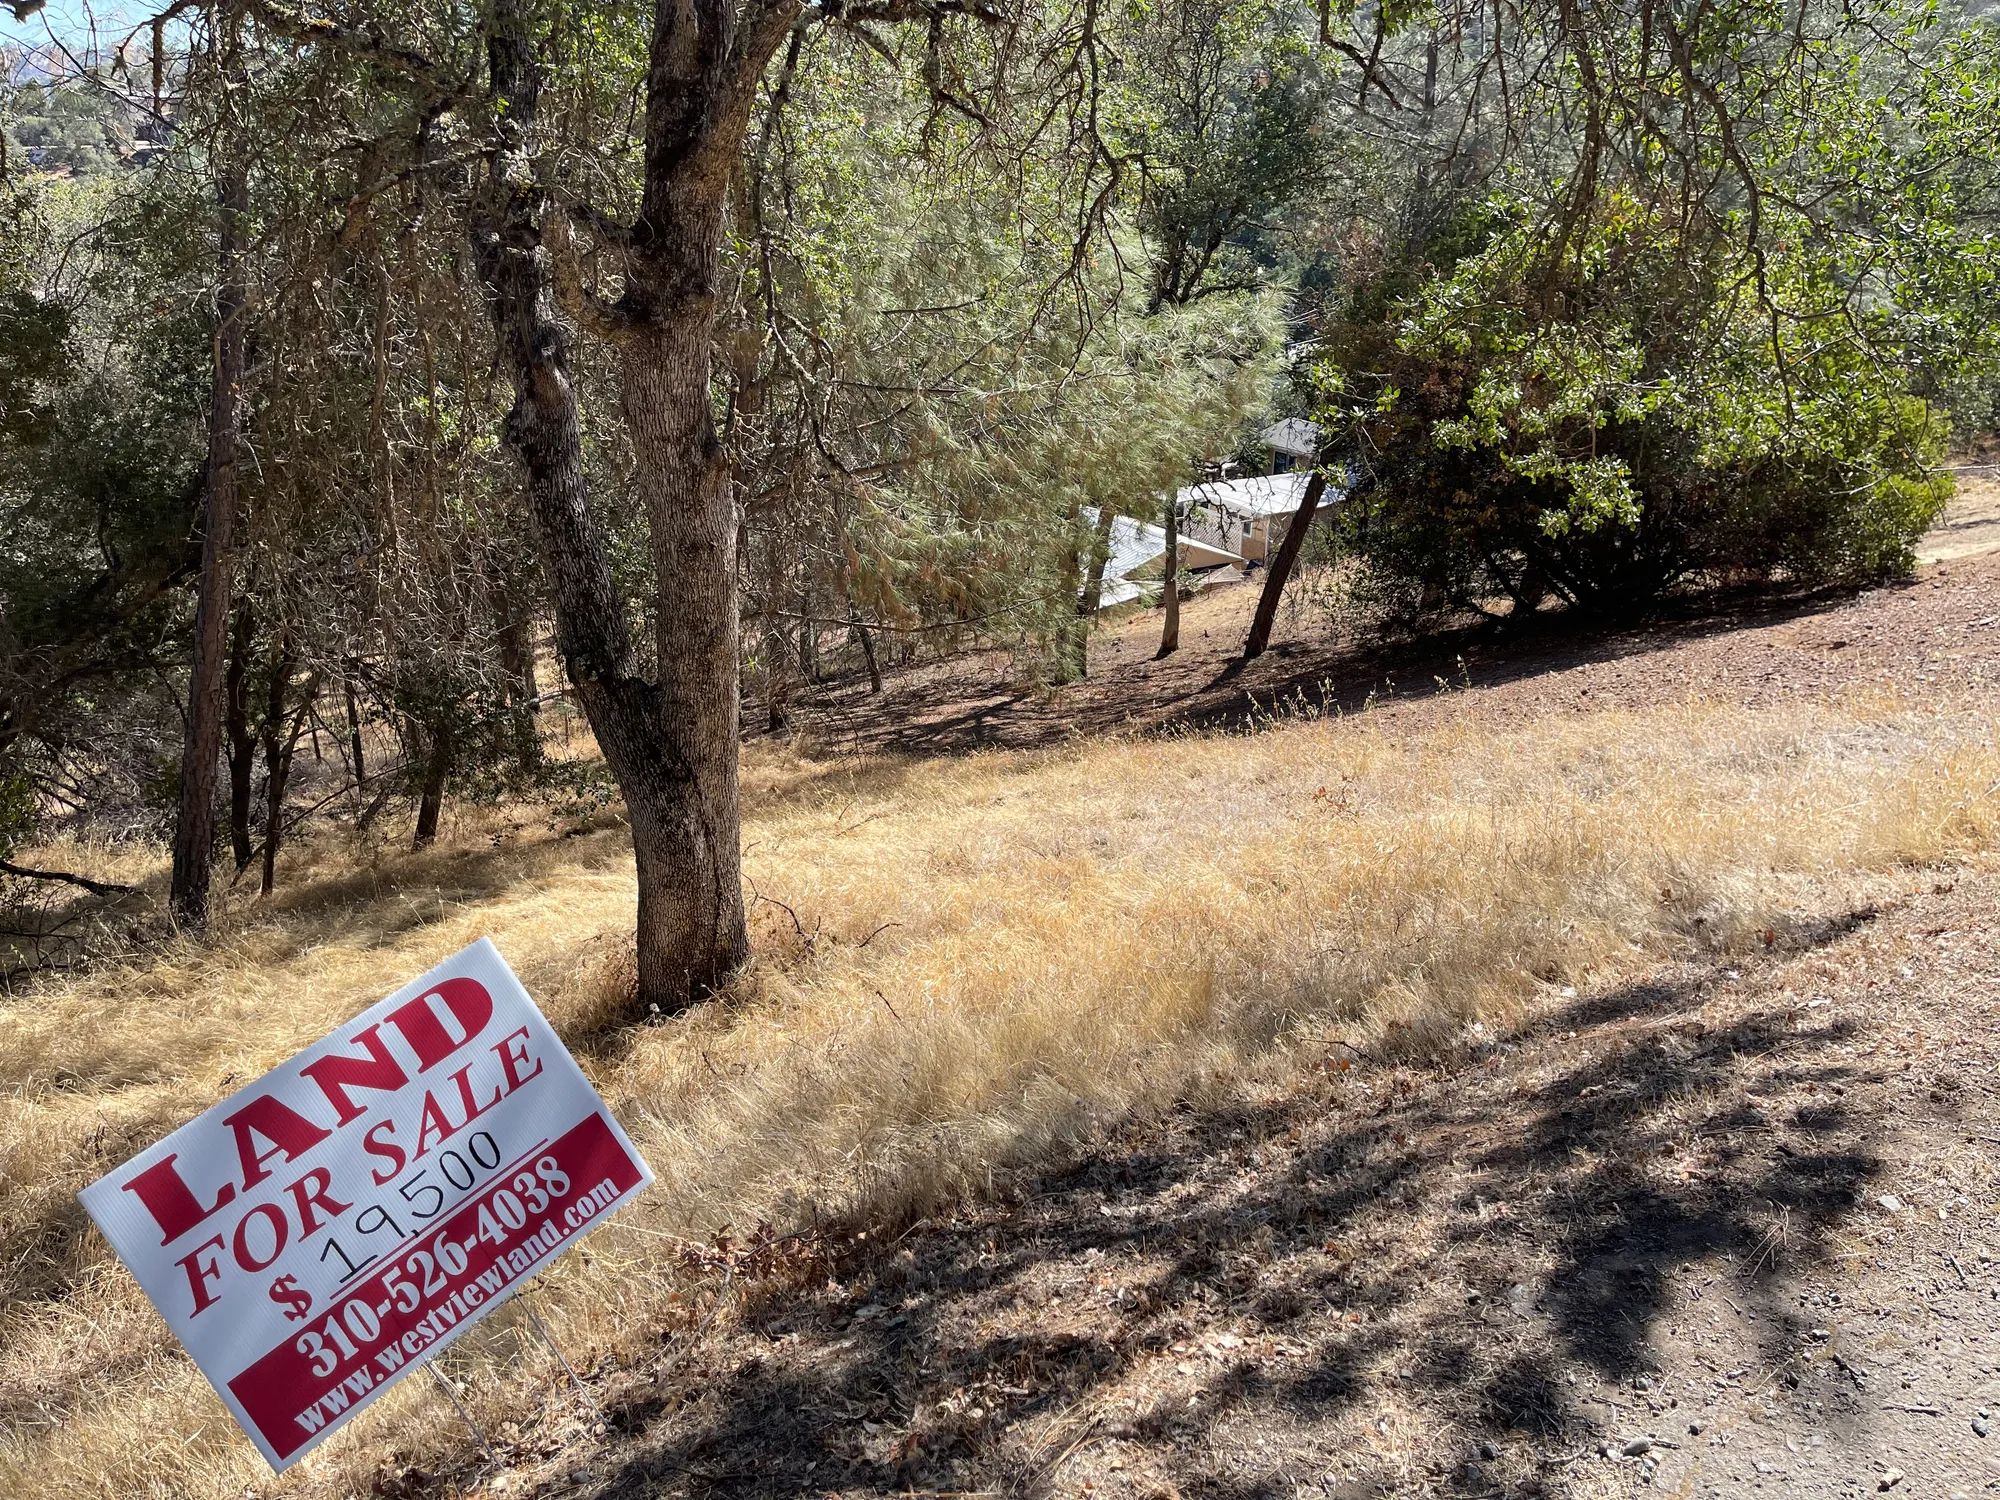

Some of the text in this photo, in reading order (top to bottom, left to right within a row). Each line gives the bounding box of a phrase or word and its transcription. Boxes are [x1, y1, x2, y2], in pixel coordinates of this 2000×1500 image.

[123, 977, 494, 1248] LAND
[174, 1025, 544, 1320] FOR SALE
[268, 1273, 314, 1322] $
[294, 1178, 621, 1436] www.westviewland.com
[297, 1155, 571, 1379] 310-526-4038
